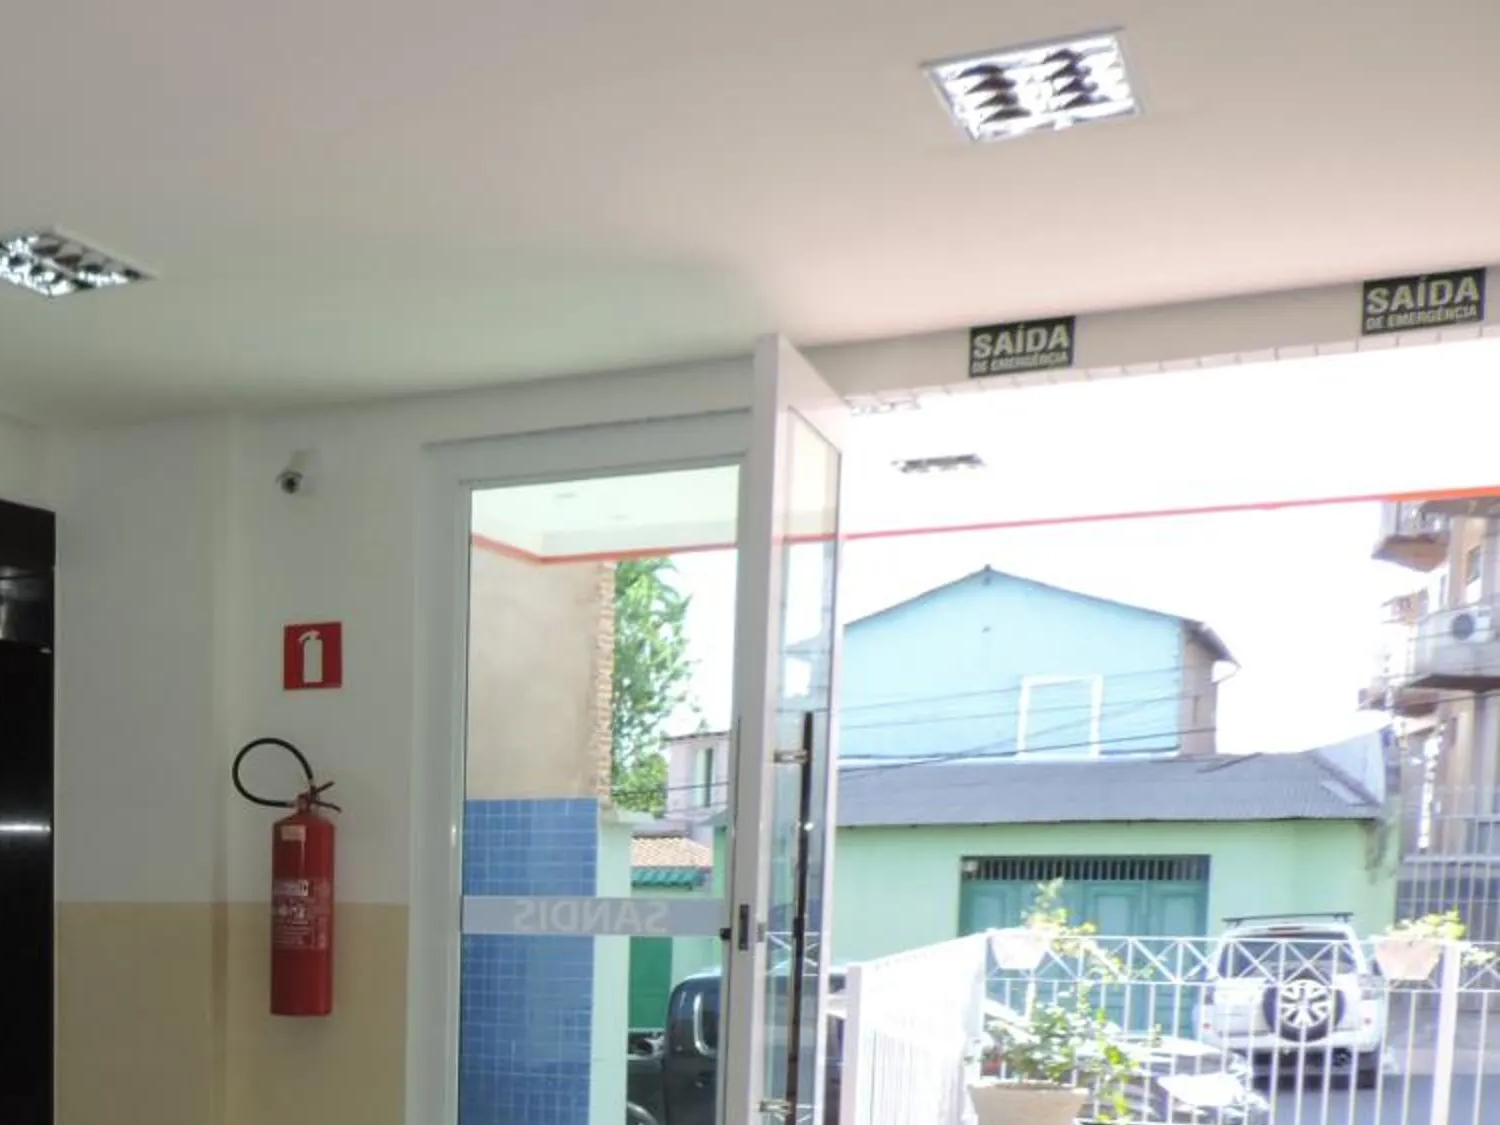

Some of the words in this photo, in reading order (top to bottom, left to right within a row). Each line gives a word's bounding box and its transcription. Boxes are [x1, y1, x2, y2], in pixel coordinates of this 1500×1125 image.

[1366, 275, 1479, 314] SAÍDA
[973, 323, 1070, 359] SAÍDA
[1366, 316, 1384, 331] DE
